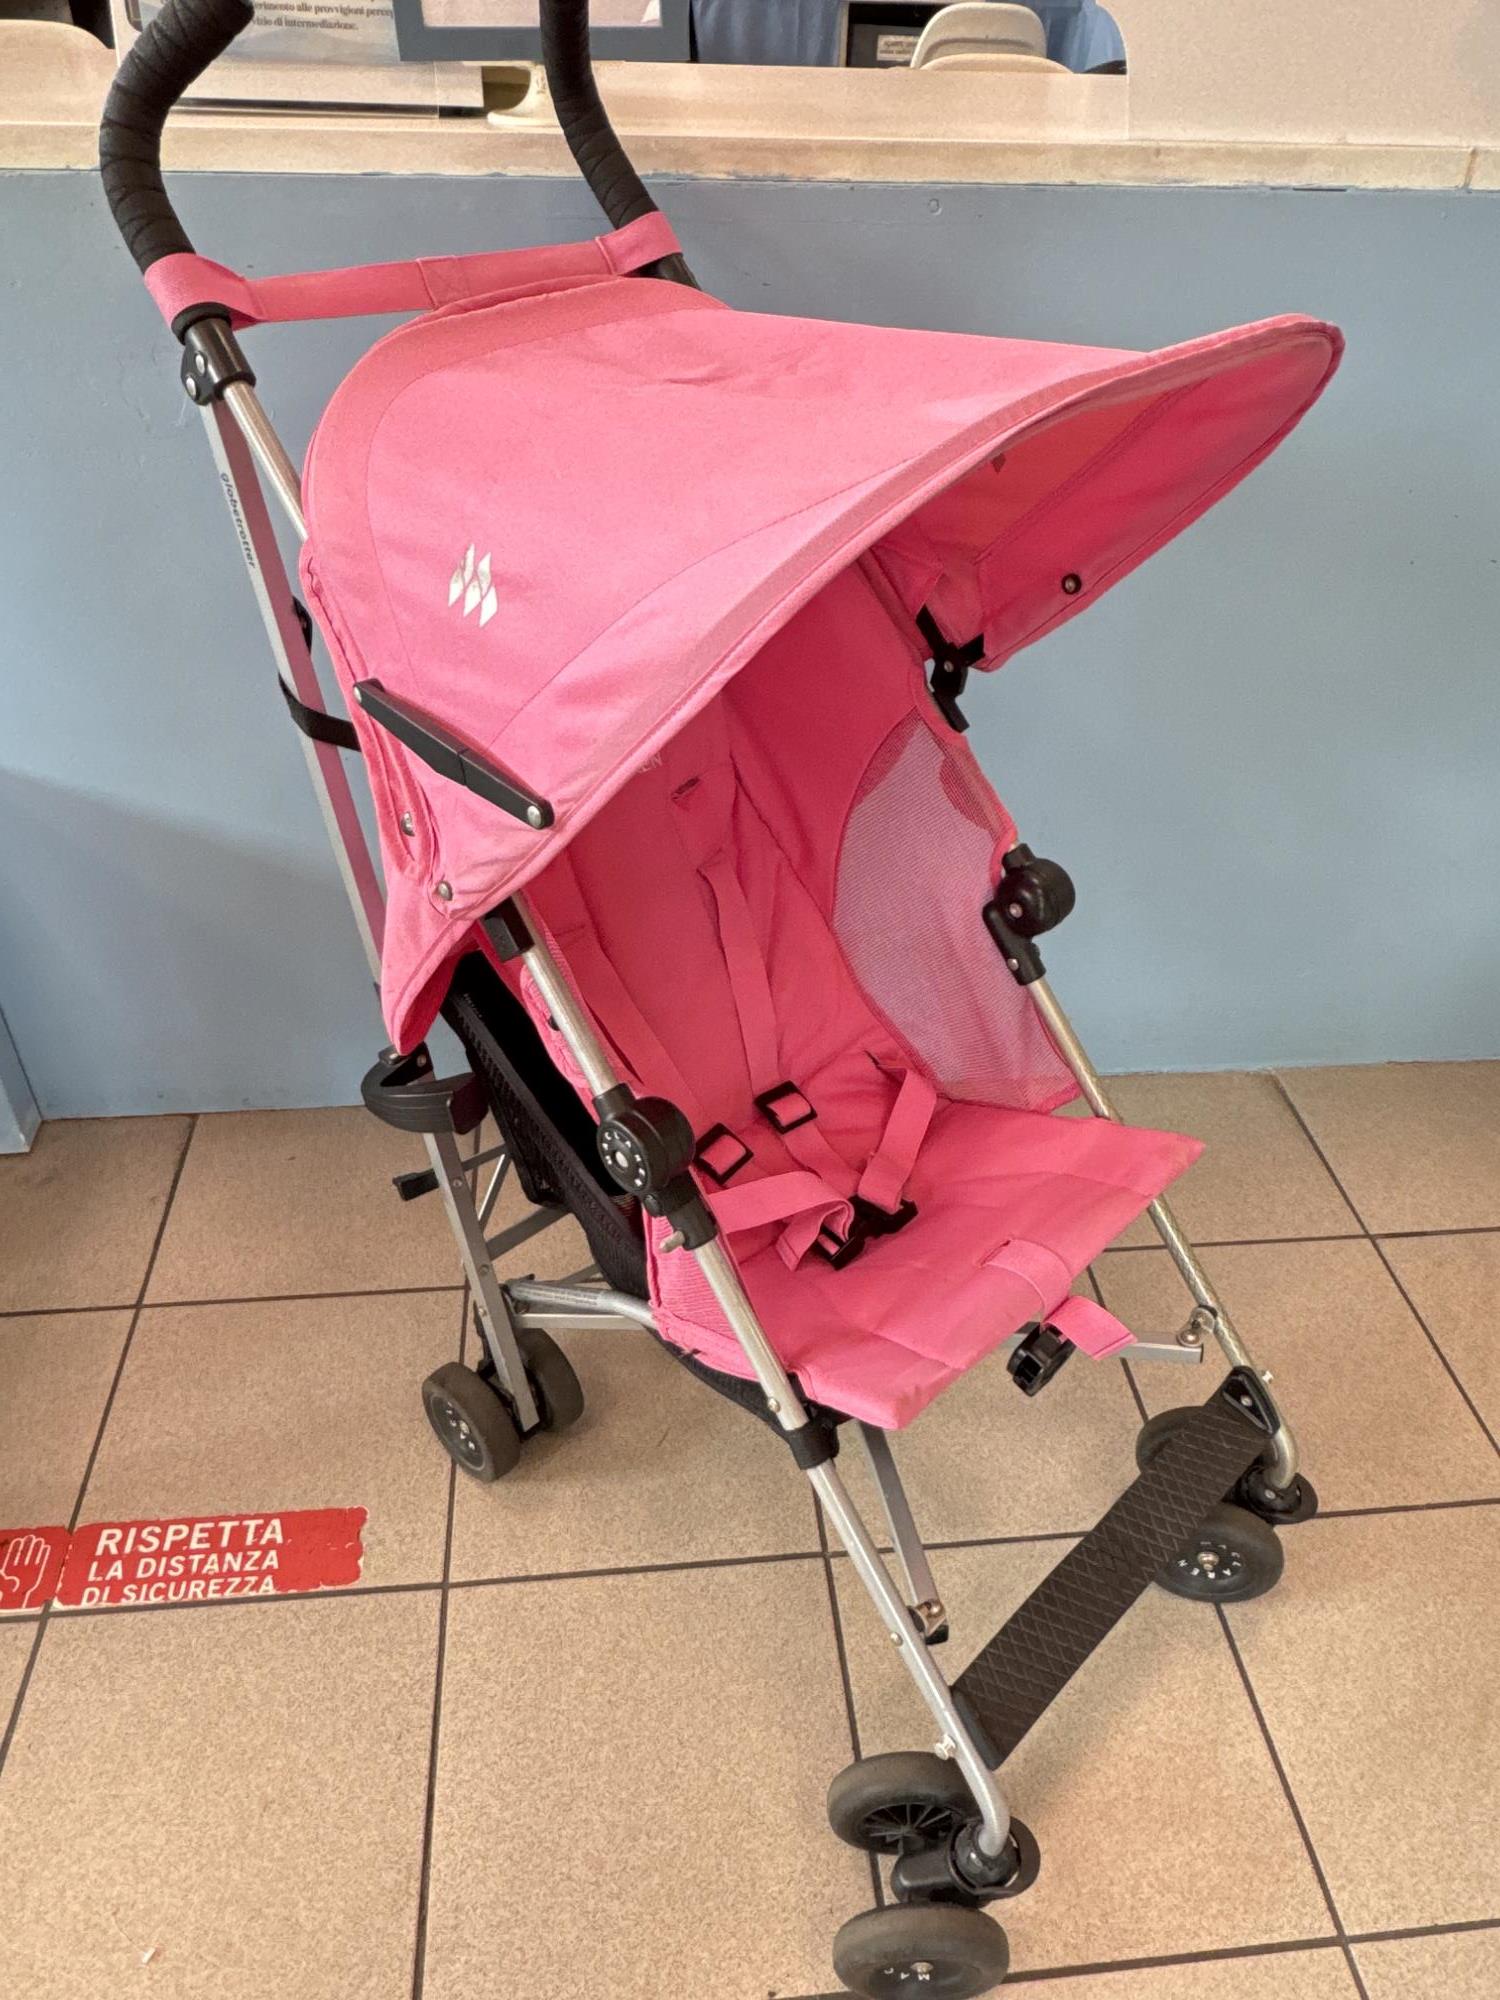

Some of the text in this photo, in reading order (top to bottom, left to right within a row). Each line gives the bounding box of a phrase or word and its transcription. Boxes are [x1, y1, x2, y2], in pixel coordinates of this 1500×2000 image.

[254, 1, 295, 11] erimento
[297, 2, 313, 12] alle
[95, 1518, 283, 1556] RISPETTA
[88, 1549, 279, 1582] LA DISTANZA
[81, 1575, 277, 1606] DI SICUREZZA
